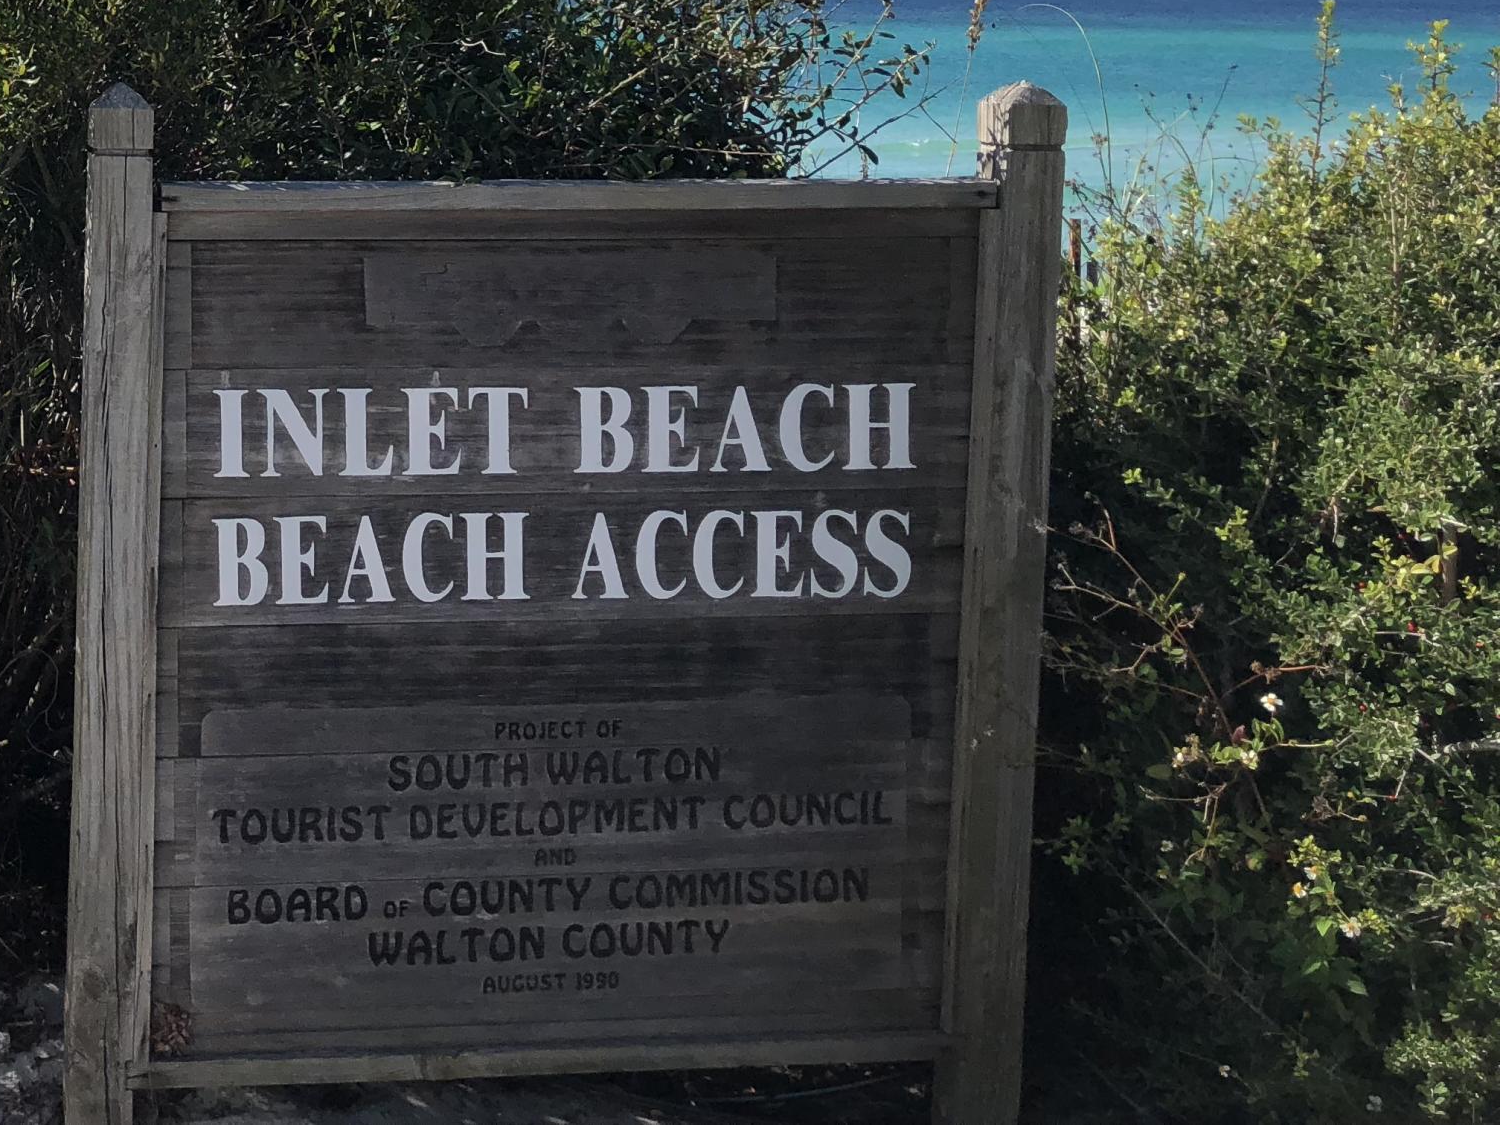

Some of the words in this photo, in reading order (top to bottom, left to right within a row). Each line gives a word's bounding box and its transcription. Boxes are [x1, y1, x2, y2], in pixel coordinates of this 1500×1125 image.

[212, 385, 529, 478] INLET
[573, 381, 918, 474] BEACH
[212, 511, 531, 606] BEACH
[571, 509, 912, 600] ACCESS
[494, 721, 587, 741] PROJECT
[596, 719, 622, 739] OF
[388, 752, 530, 791] SOUTH
[546, 746, 722, 787] WALTON
[212, 805, 392, 845] TOURIST
[409, 796, 705, 840] DEVELOPMENT
[721, 792, 893, 829] COUNCIL
[535, 847, 577, 867] AND
[227, 885, 368, 925] BOARD
[384, 899, 409, 919] OF
[423, 876, 590, 918] COUNTY
[608, 868, 870, 910] COMMISSION
[368, 925, 547, 967] WALTON
[560, 919, 731, 960] COUNTY
[483, 972, 566, 994] AUGUST
[575, 969, 619, 990] 1990
